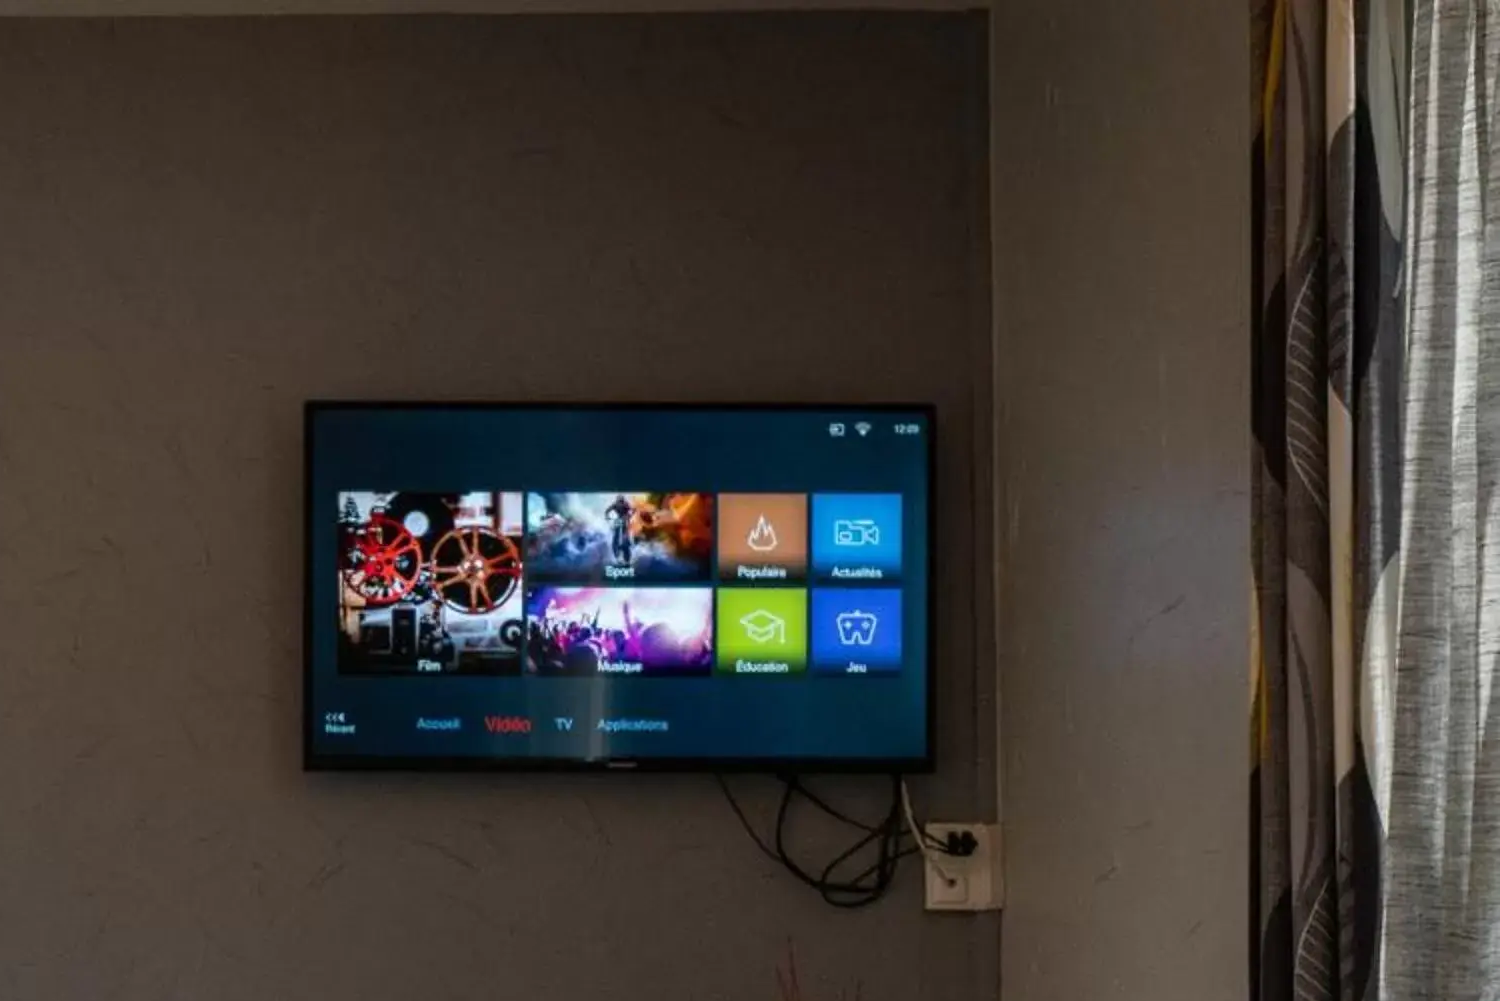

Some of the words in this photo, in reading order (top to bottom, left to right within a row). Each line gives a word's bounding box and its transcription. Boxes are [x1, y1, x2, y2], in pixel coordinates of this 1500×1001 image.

[604, 565, 635, 579] Sport
[737, 565, 787, 579] Populaire
[831, 565, 882, 578] Actualités
[417, 659, 442, 671] Film
[597, 659, 643, 673] Musique
[735, 658, 788, 672] Éducation
[846, 661, 867, 672] Jeu
[416, 717, 461, 730] Accueil
[484, 714, 531, 732] Vidéo
[554, 718, 573, 731] TV
[597, 717, 669, 733] Applications
